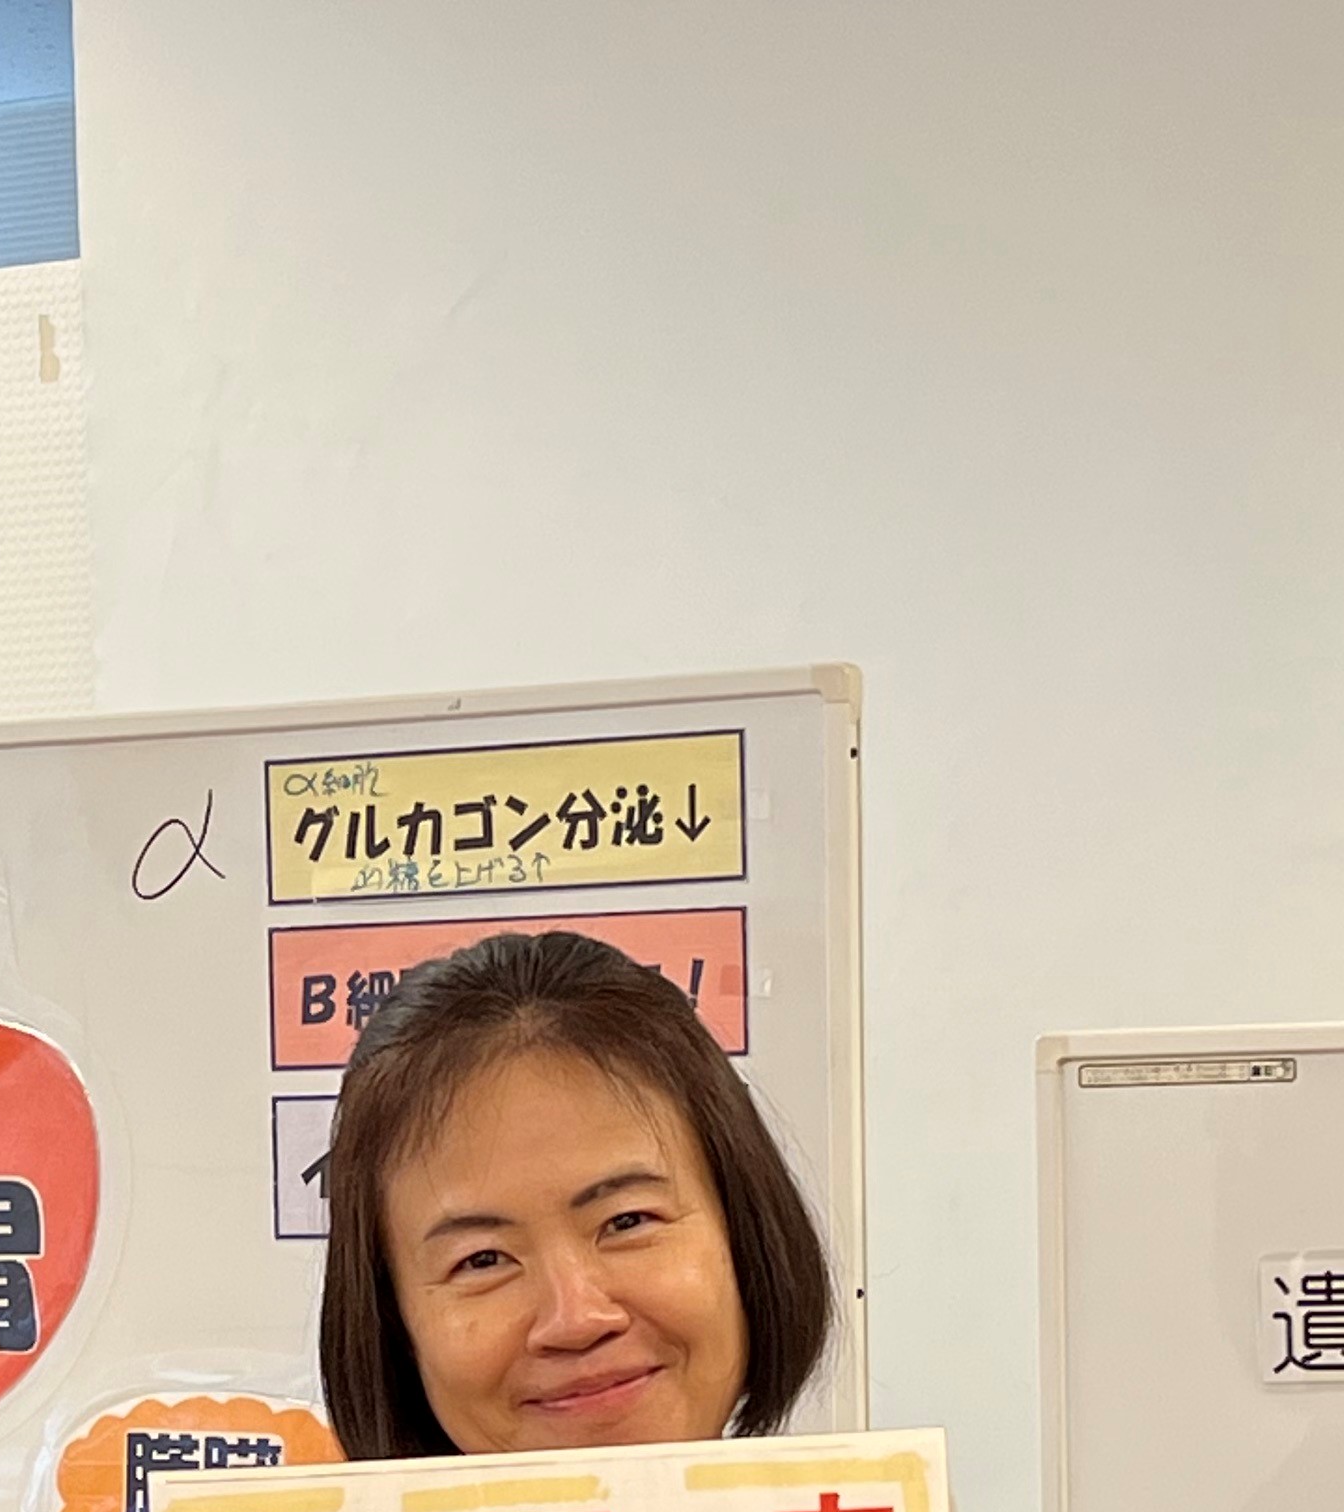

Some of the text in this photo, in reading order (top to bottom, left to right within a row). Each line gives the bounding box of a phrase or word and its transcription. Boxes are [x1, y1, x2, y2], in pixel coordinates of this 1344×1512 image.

[294, 784, 664, 862] グルカゴン分泌
